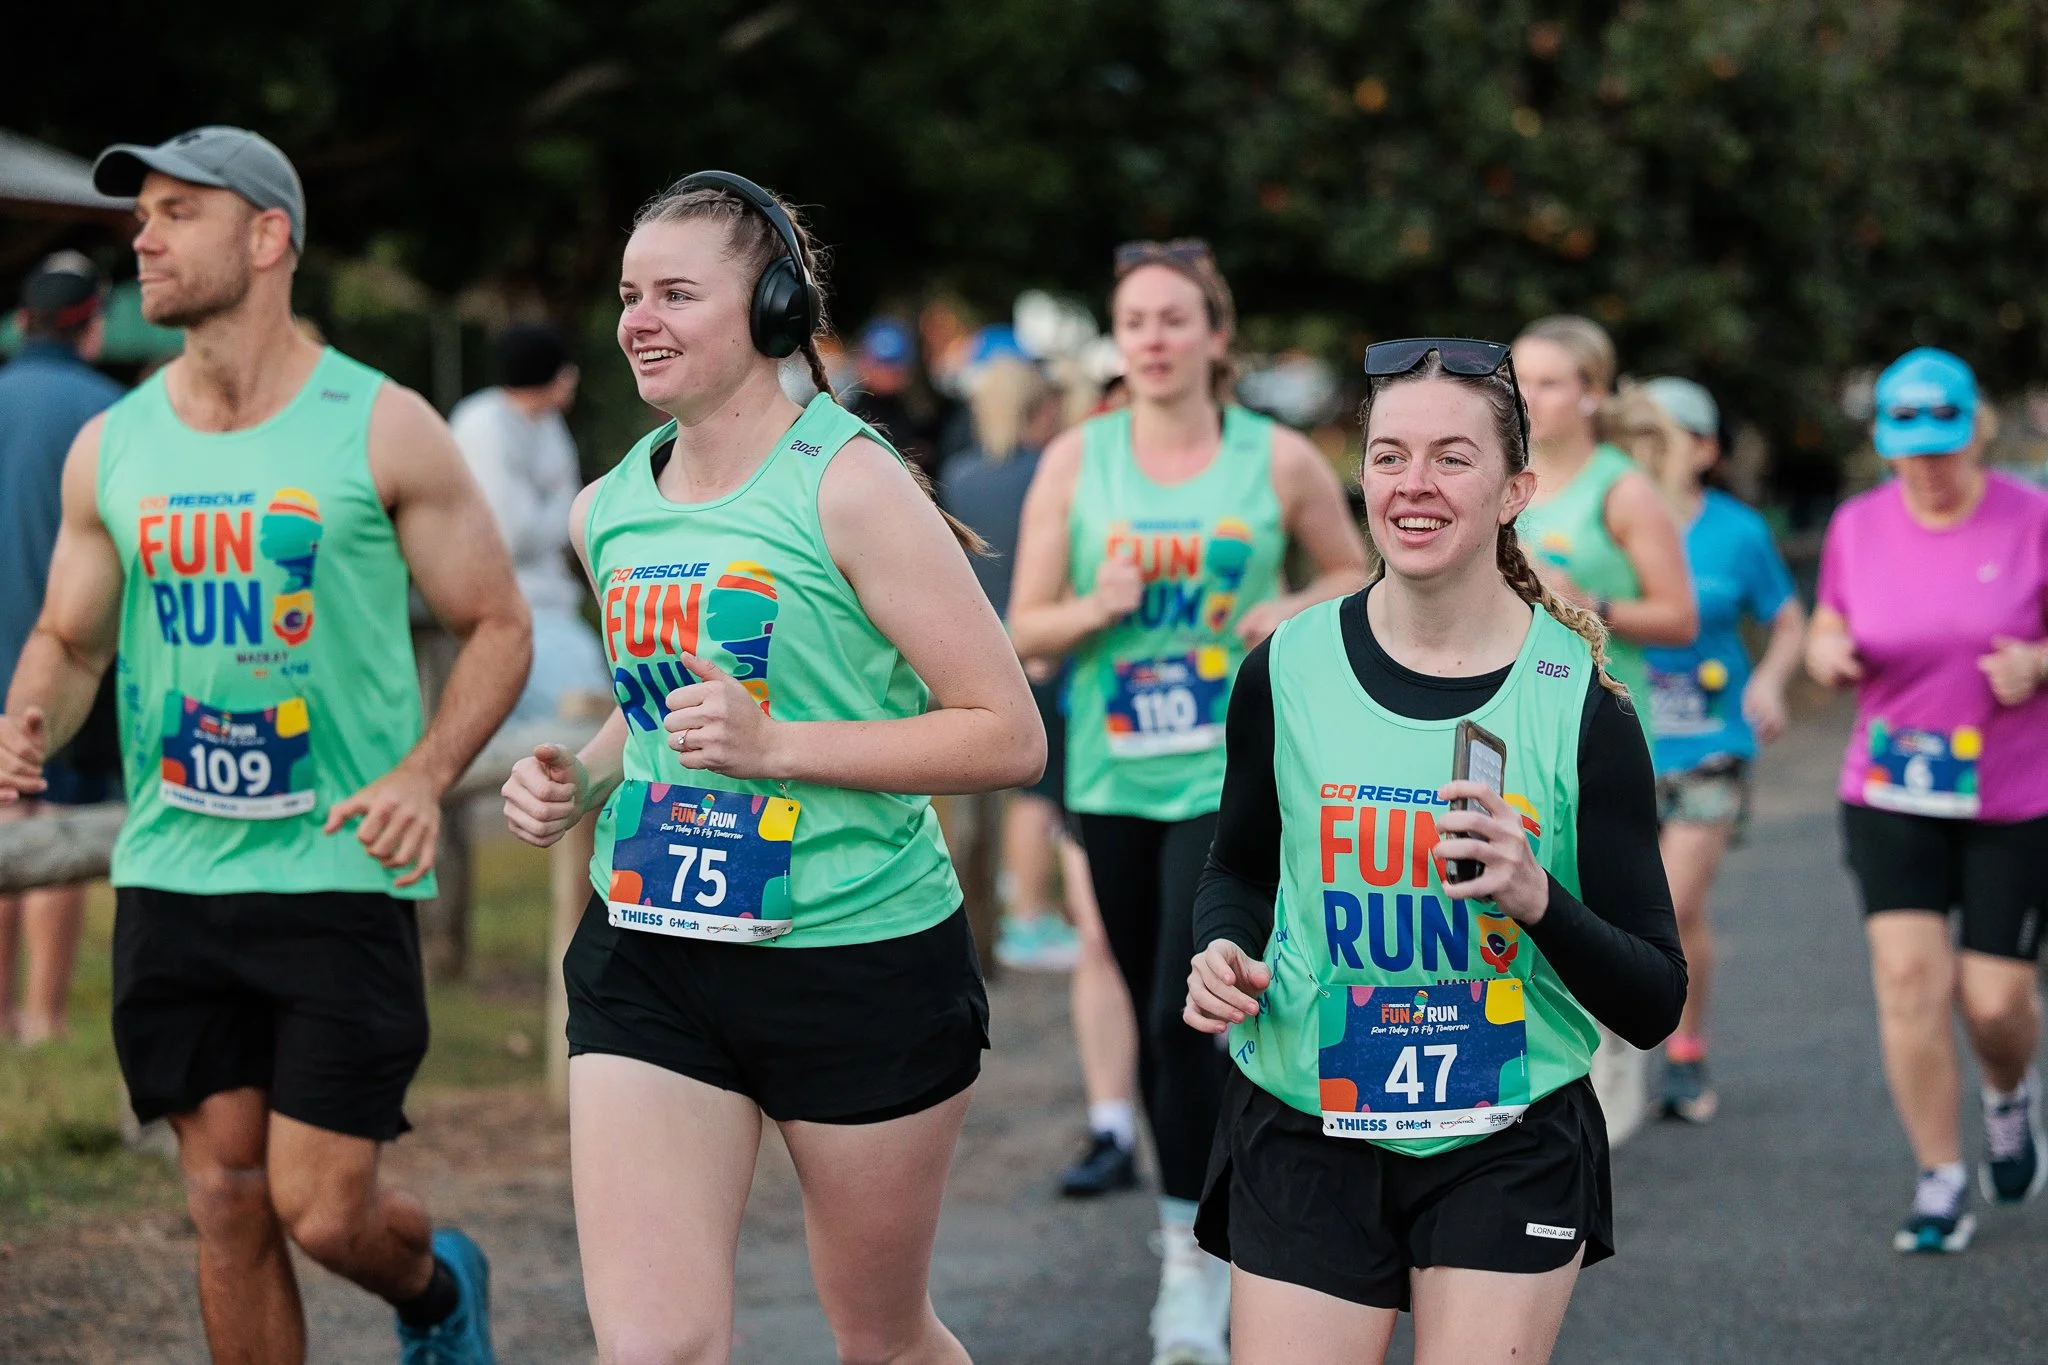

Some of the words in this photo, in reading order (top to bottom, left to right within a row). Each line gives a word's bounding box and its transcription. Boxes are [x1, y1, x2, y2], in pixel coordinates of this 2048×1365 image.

[790, 439, 823, 457] 2025
[139, 511, 253, 577] FUN
[152, 580, 263, 646] RUN
[606, 583, 702, 662] FUN
[1536, 659, 1571, 679] 2025
[190, 743, 271, 796] 109
[1320, 783, 1450, 806] CQRESCU
[670, 806, 697, 824] FUN
[709, 811, 738, 829] RUN
[660, 823, 675, 832] Run
[675, 824, 692, 836] Today
[693, 827, 701, 835] To
[701, 828, 713, 839] Fly
[714, 830, 744, 839] Tomorrow
[668, 843, 727, 907] 75
[621, 909, 663, 926] THIESS
[1323, 890, 1468, 973] RUN
[1381, 1008, 1411, 1024] FUN
[1427, 1005, 1458, 1022] RUN
[1371, 1026, 1387, 1035] Run
[1389, 1025, 1409, 1036] Today
[1411, 1025, 1419, 1034] To
[1421, 1025, 1433, 1035] Fly
[1436, 1024, 1470, 1033] Tomorrow
[1385, 1044, 1458, 1104] 47
[1336, 1117, 1388, 1132] THIESS
[1532, 1226, 1557, 1236] LORNA
